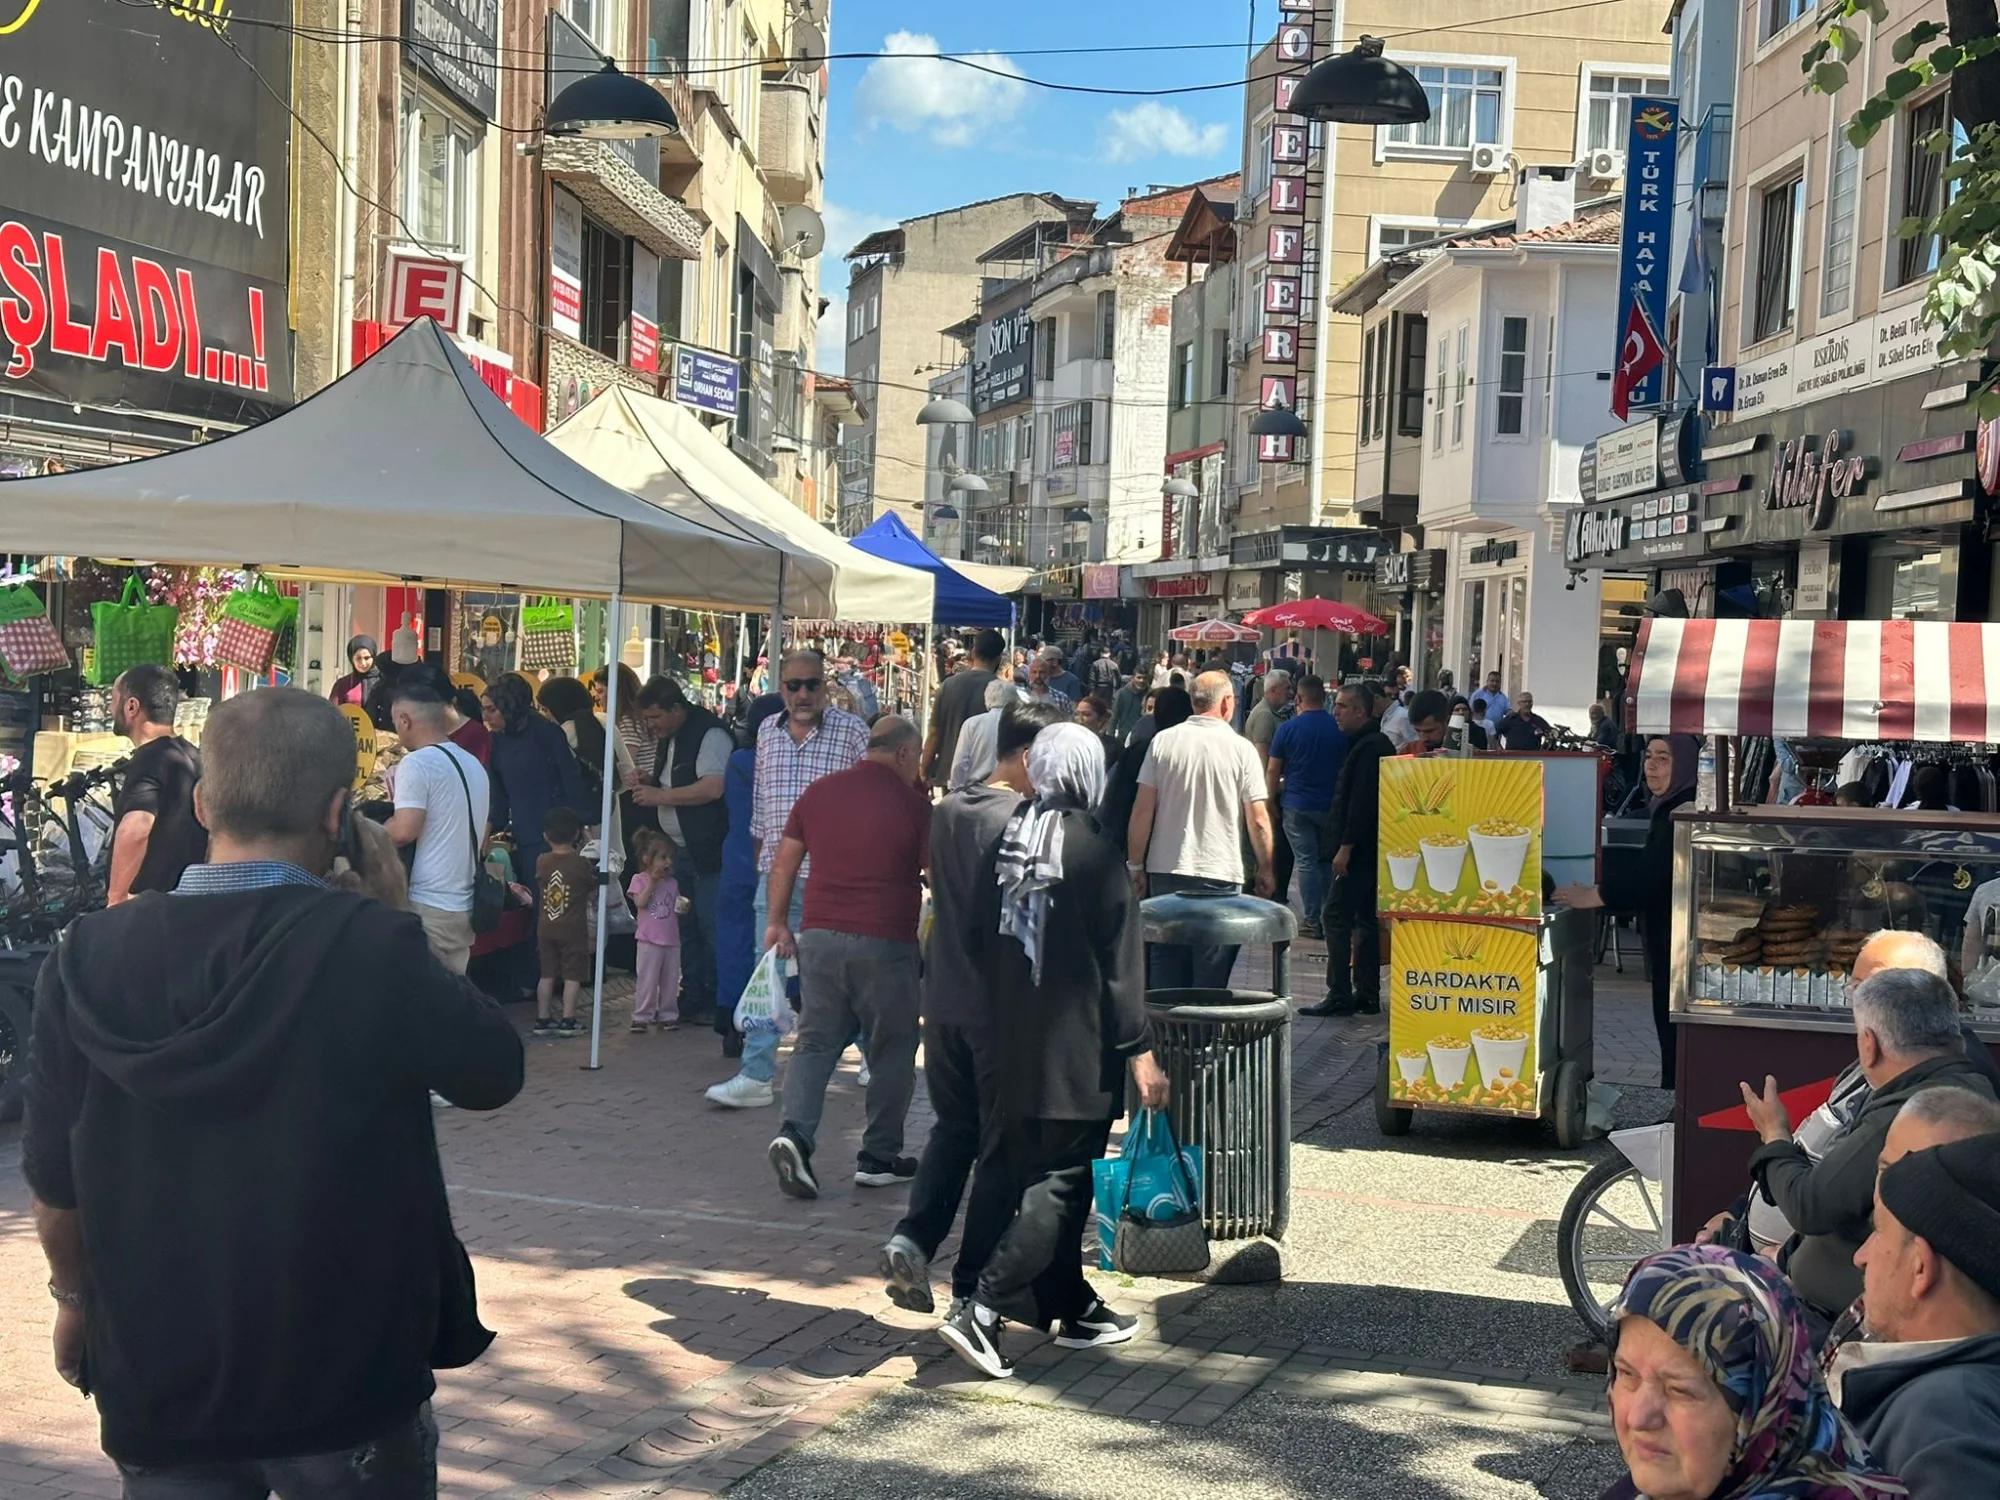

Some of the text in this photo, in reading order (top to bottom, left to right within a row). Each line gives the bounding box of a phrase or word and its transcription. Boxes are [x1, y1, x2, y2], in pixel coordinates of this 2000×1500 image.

[0, 74, 265, 240] E KAMPANYALAR
[1640, 151, 1660, 212] TÜRK
[1636, 231, 1656, 293] HAVA
[403, 267, 448, 322] E
[1761, 428, 1865, 531] Nilüfer
[1406, 970, 1520, 992] BARDAKTA
[1410, 992, 1516, 1016] SÜT MISIR
